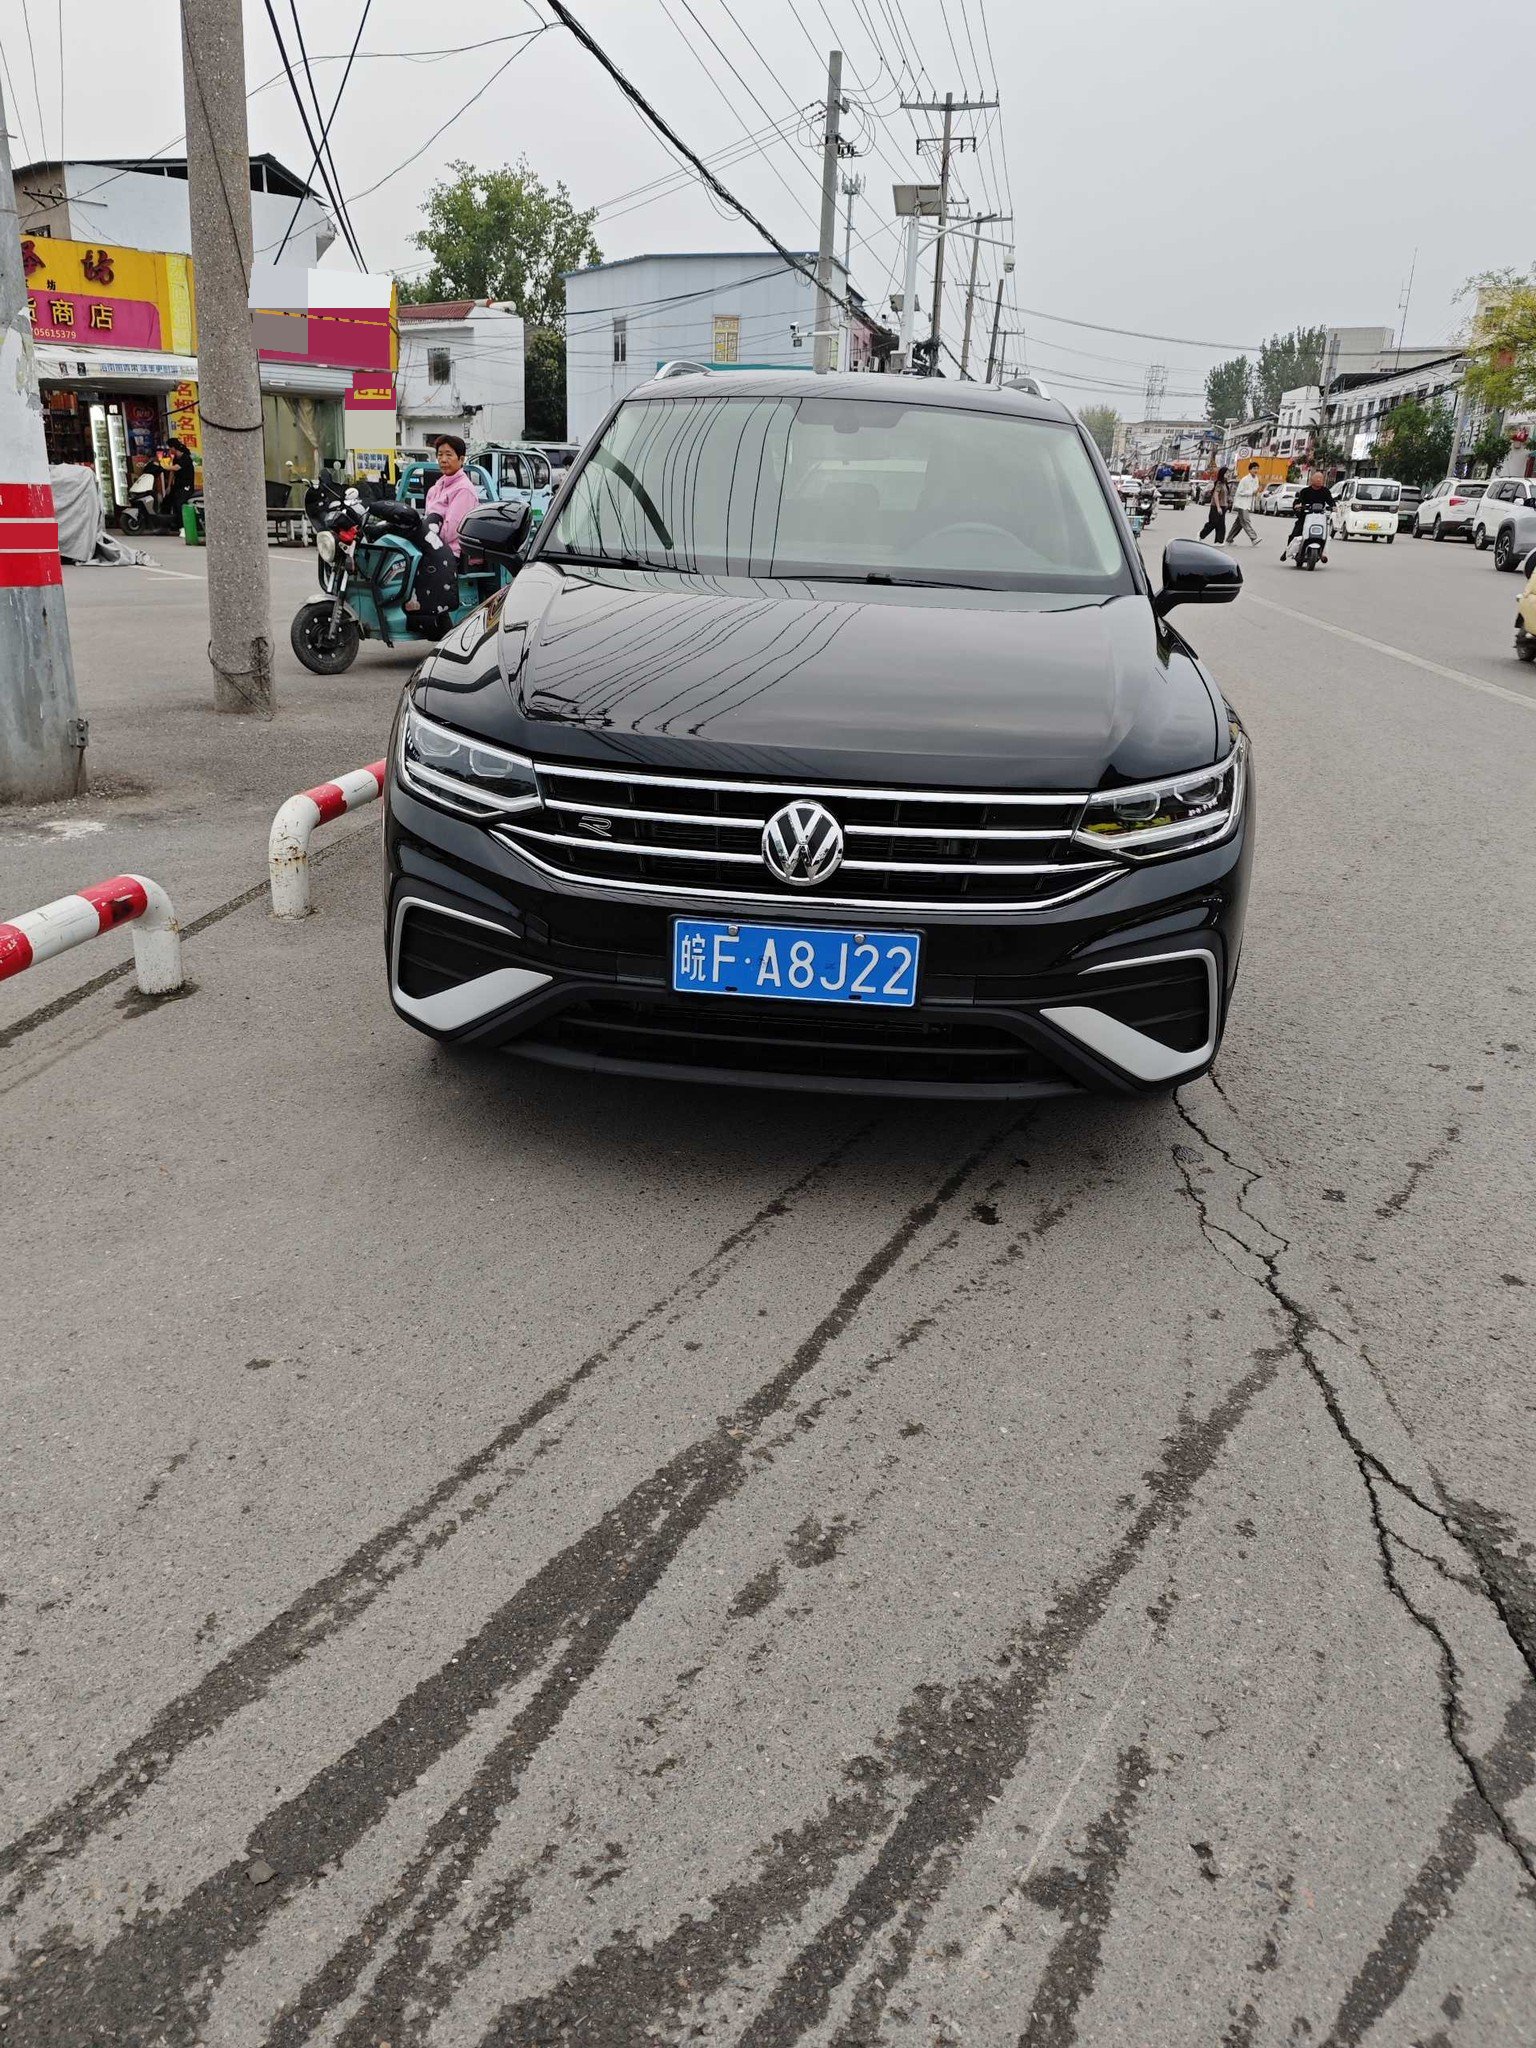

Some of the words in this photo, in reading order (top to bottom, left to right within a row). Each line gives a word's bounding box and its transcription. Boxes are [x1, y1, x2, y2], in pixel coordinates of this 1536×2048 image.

[31, 327, 77, 340] 05615379
[173, 382, 198, 449] 名烟名酒
